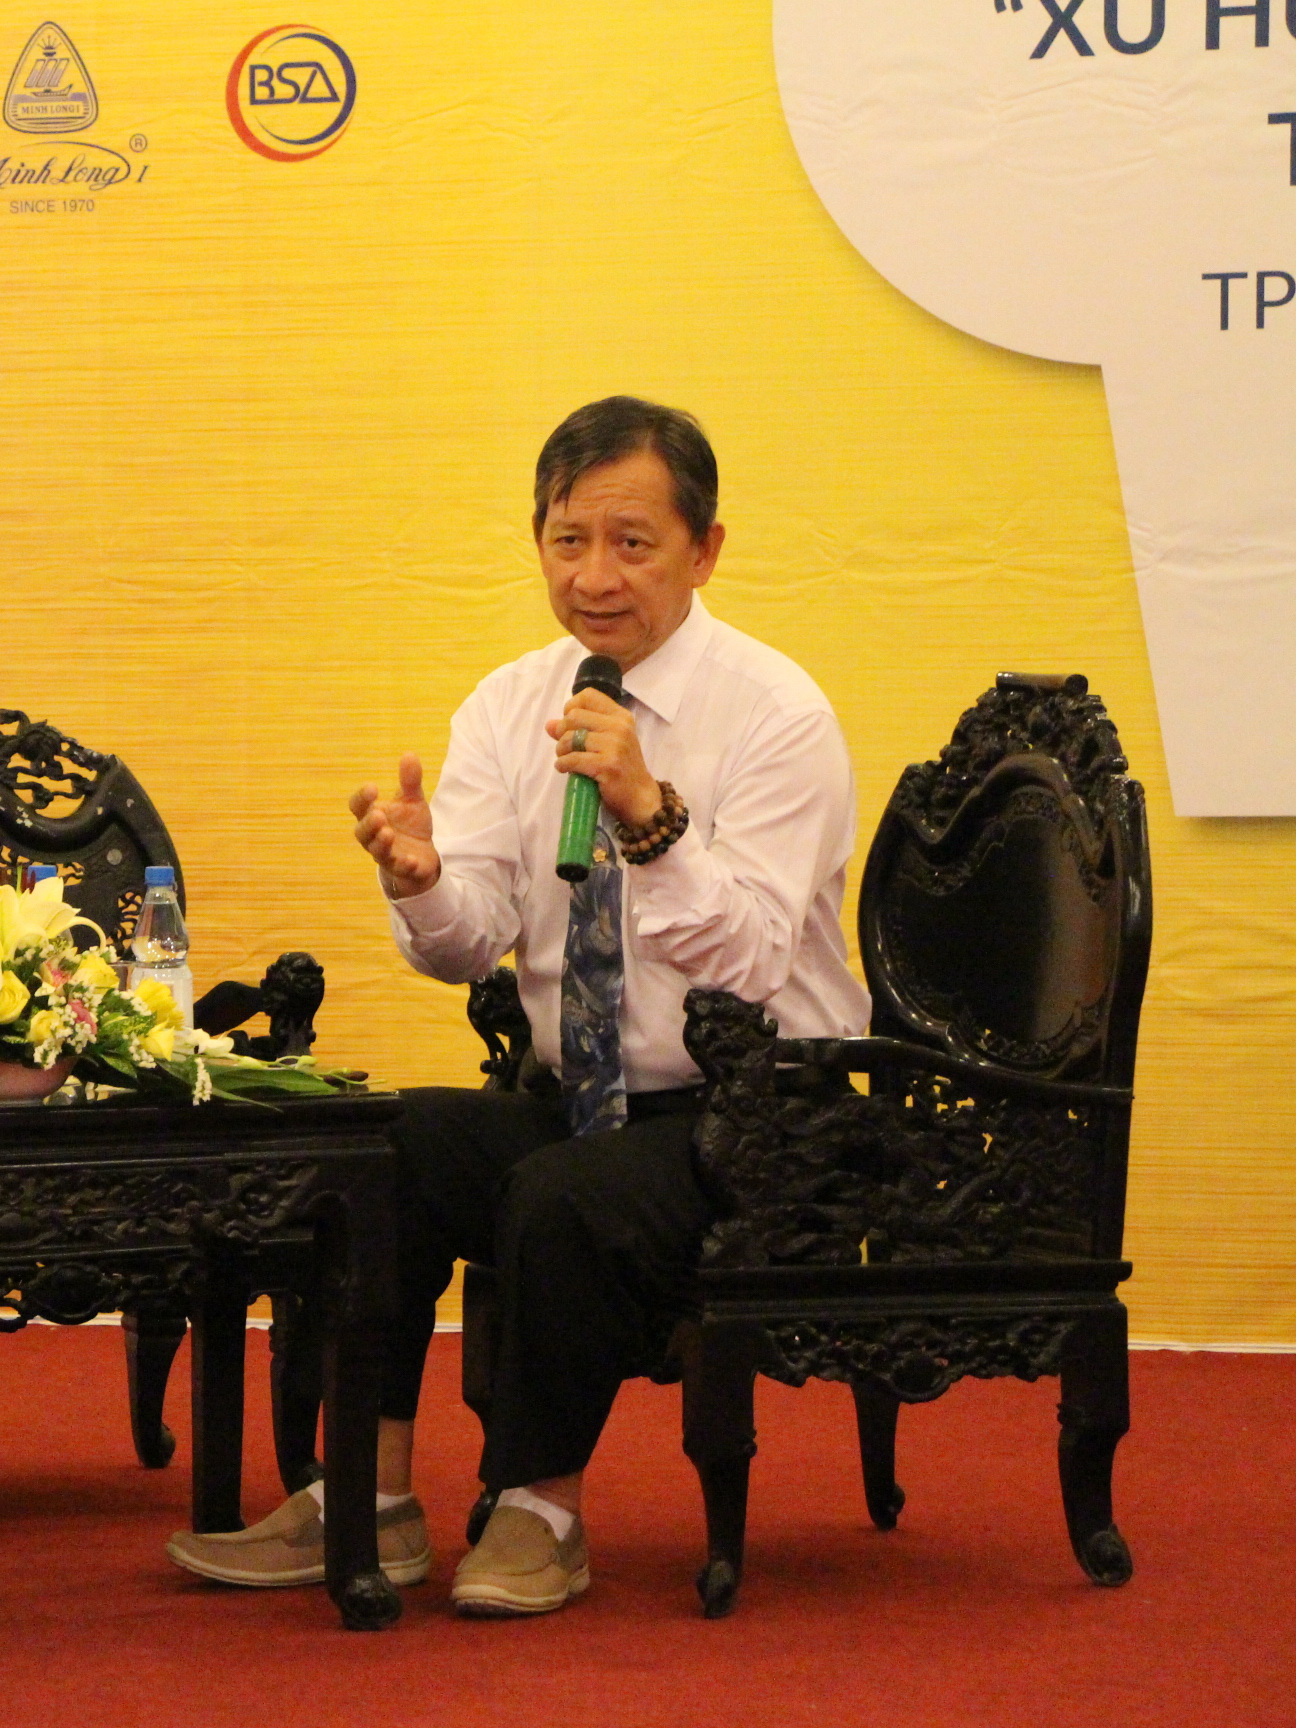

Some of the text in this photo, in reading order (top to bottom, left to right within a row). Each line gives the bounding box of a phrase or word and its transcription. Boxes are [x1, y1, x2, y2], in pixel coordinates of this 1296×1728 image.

[1205, 0, 1296, 50] H
[249, 61, 341, 105] BSA
[21, 105, 48, 115] MINH
[50, 104, 75, 114] LONG
[50, 148, 131, 191] Long
[10, 199, 95, 214] SINCE 1970
